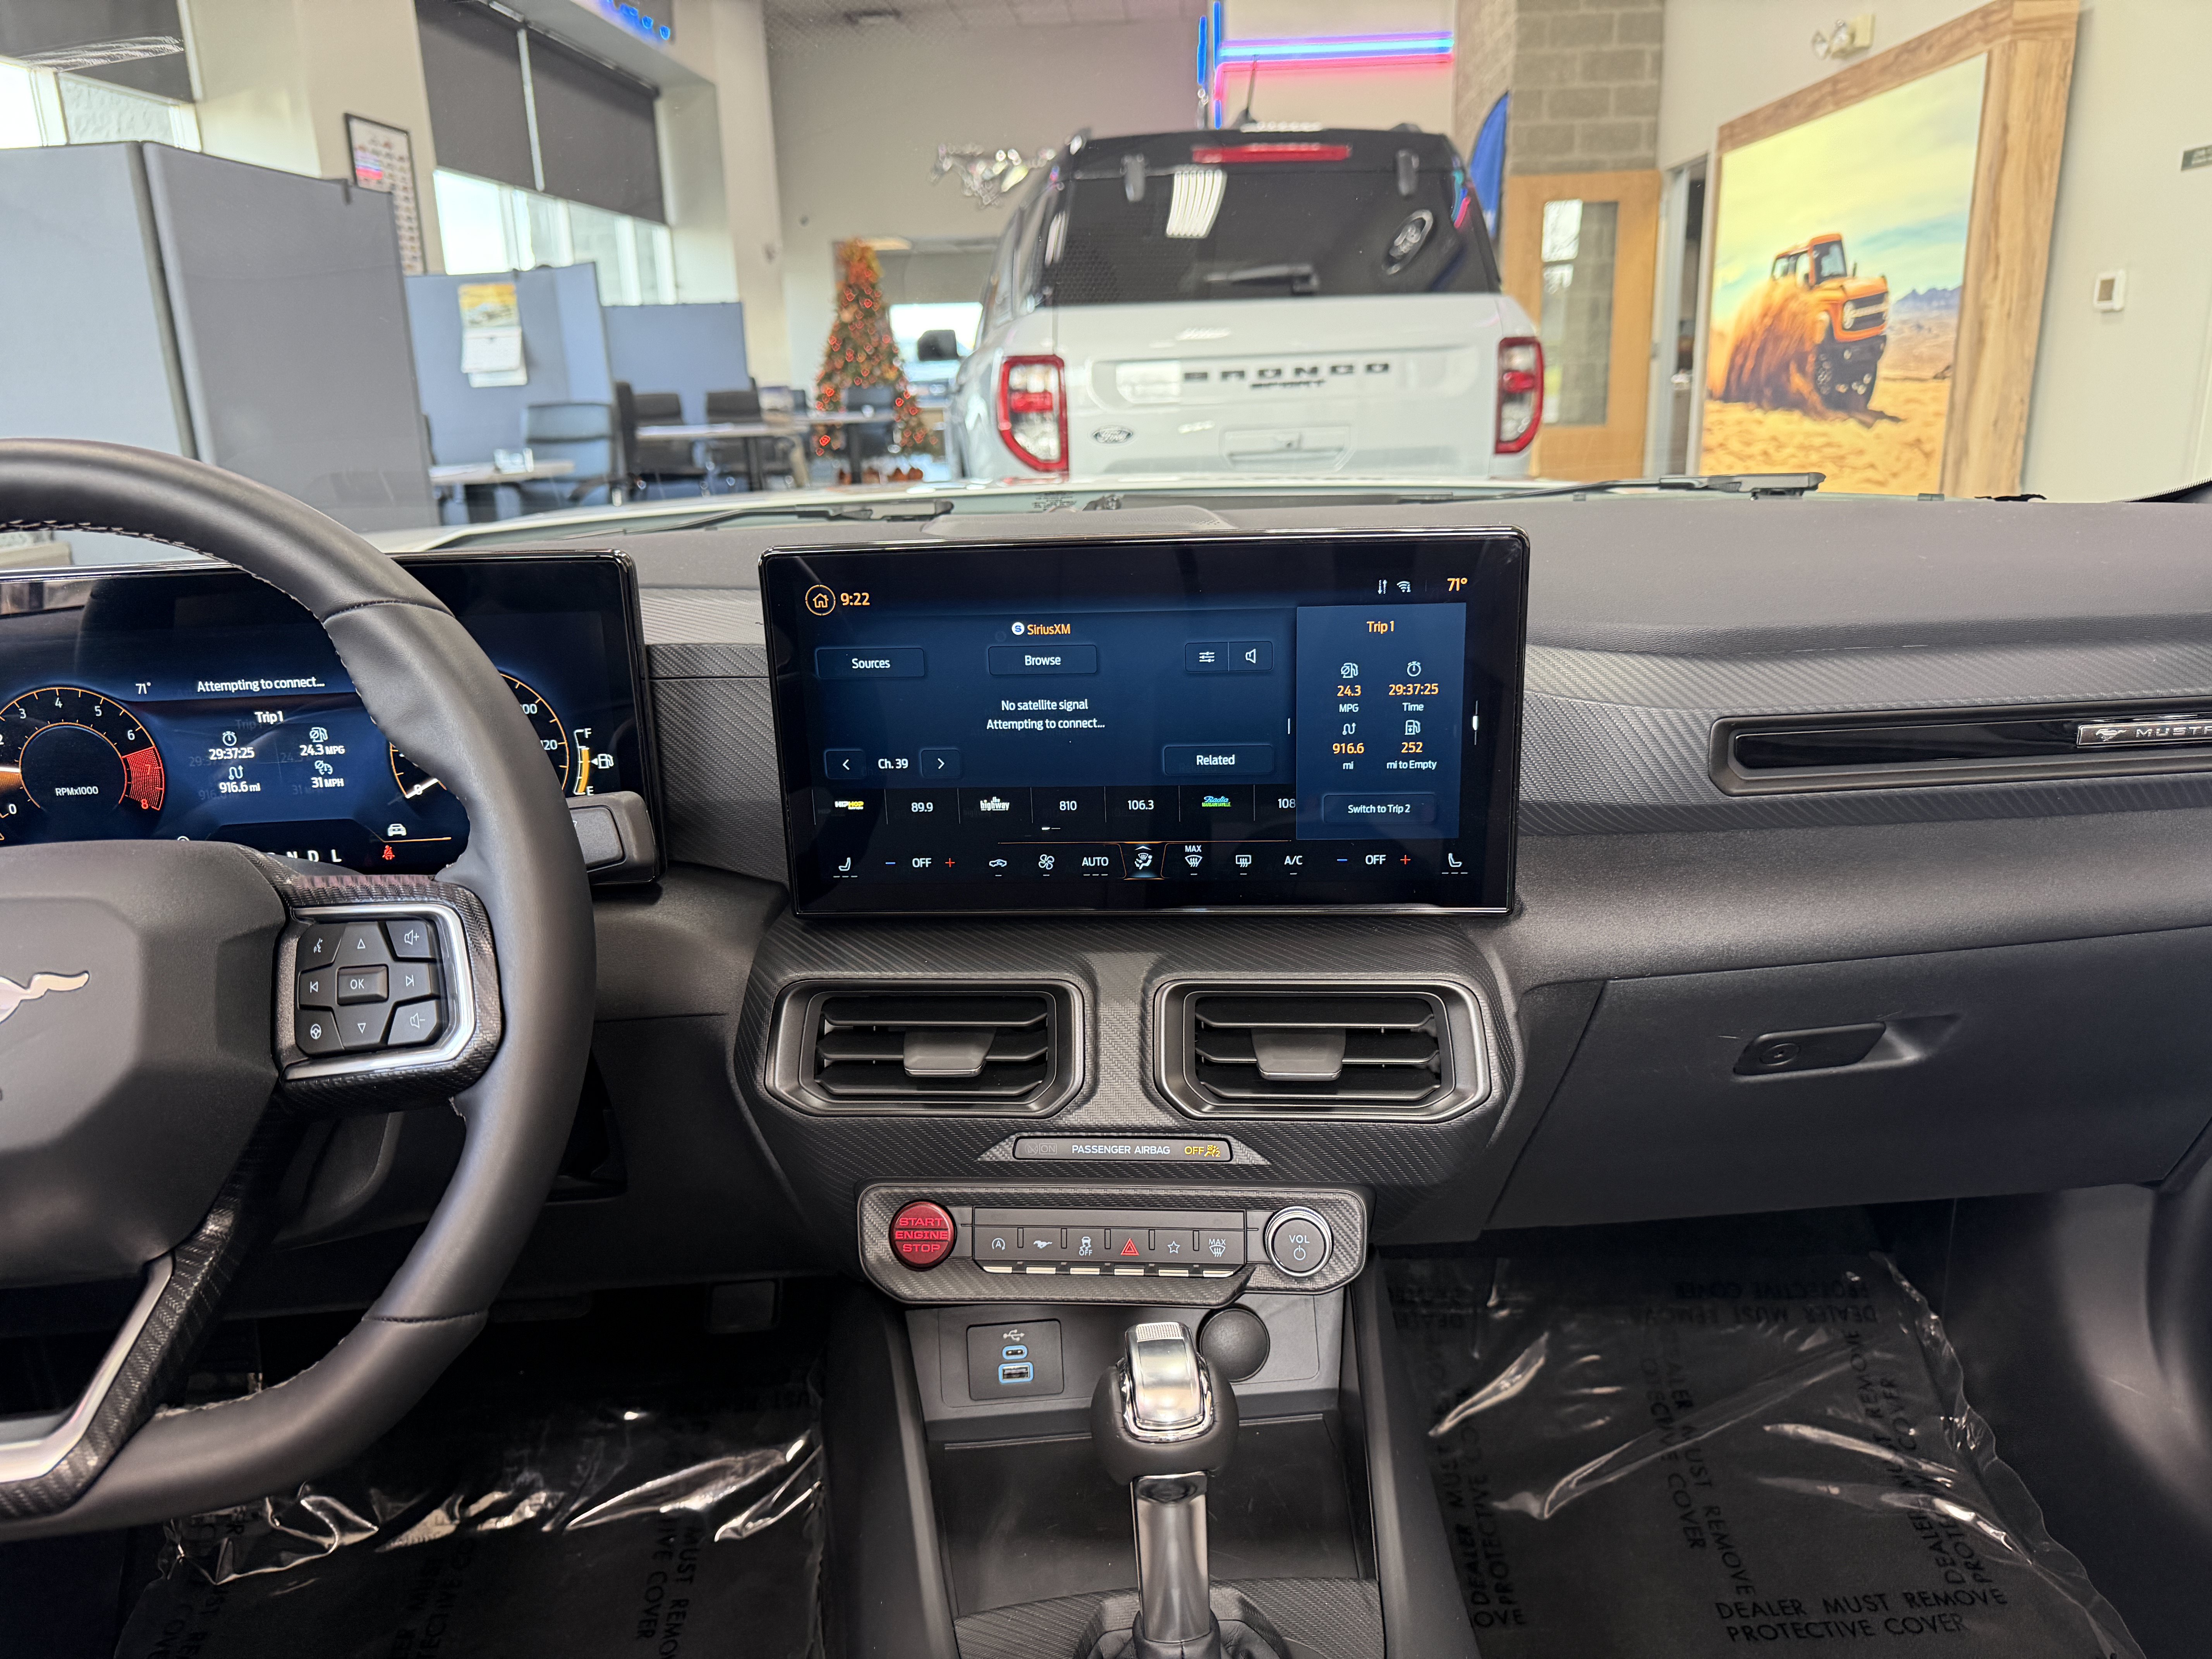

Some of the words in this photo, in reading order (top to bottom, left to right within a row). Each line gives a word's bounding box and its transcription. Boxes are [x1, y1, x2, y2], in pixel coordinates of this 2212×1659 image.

[1184, 363, 1390, 381] BRONCO
[1448, 578, 1467, 591] 71°
[841, 592, 870, 605] 9:22
[1027, 624, 1070, 635] SiriusXM
[1367, 621, 1388, 634] Trip
[1390, 621, 1394, 631] 1
[852, 658, 890, 668] Sources
[1025, 655, 1061, 665] Browse
[136, 682, 151, 694] 71°
[198, 679, 259, 692] Attempting
[261, 679, 273, 689] to
[273, 677, 325, 689] connect...
[1389, 684, 1438, 695] 29:37:25
[1337, 685, 1361, 696] 24.3
[55, 697, 63, 708] 4
[1001, 701, 1015, 710] No
[1018, 700, 1057, 710] satellite
[1058, 699, 1088, 711] signal
[1402, 702, 1424, 711] Time
[19, 708, 26, 718] 3
[94, 706, 102, 716] 5
[522, 704, 538, 715] 00
[1340, 704, 1359, 712] MPG
[254, 711, 276, 724] Trip
[278, 711, 283, 722] 1
[987, 719, 1043, 731] Attempting
[1045, 719, 1056, 728] to
[1058, 718, 1105, 728] connect...
[128, 730, 135, 740] 6
[584, 728, 591, 738] F
[300, 744, 324, 756] 24.3
[326, 745, 345, 754] MPG
[1333, 743, 1364, 754] 916.6
[1401, 742, 1422, 752] 252
[209, 747, 254, 760] 29:37:25
[878, 759, 894, 769] Ch.
[896, 759, 908, 768] 39
[1197, 754, 1235, 765] Related
[1387, 761, 1397, 769] mi
[1409, 760, 1437, 770] Empty
[219, 781, 248, 793] 916.6
[249, 783, 260, 792] mi
[311, 777, 323, 788] 31
[325, 778, 344, 787] MPH
[55, 786, 98, 796] RPMx1000
[587, 786, 594, 795] E
[141, 799, 148, 809] 8
[912, 802, 933, 812] 89.9
[980, 800, 1010, 811] highway
[1060, 801, 1077, 811] 810
[1128, 800, 1154, 810] 106.3
[1278, 799, 1295, 808] 108
[9, 804, 17, 814] 0
[1348, 805, 1377, 813] Switch
[1388, 804, 1403, 814] Trip
[1405, 804, 1410, 812] 2
[307, 850, 319, 862] D
[331, 849, 342, 862] L
[1285, 856, 1302, 865] A/C
[1365, 855, 1386, 864] OFF
[912, 858, 931, 867] OFF
[1082, 857, 1108, 866] AUTO
[350, 979, 364, 989] OK
[1072, 1145, 1131, 1154] PASSENGER
[1134, 1146, 1170, 1155] AIRBAG
[1184, 1146, 1204, 1155] OFF
[899, 1217, 942, 1227] START
[895, 1230, 949, 1240] ENGINE
[1288, 1235, 1310, 1243] VOL
[902, 1243, 941, 1253] STOP
[1668, 1473, 1707, 1549] COVER
[1704, 1505, 1757, 1595] REMOVE
[635, 1571, 667, 1639] COVER
[1714, 1599, 1807, 1620] DEALER
[1822, 1593, 1888, 1615] MUST
[1904, 1587, 2008, 1611] REMOVE
[1473, 1608, 1528, 1630] OVE
[1726, 1619, 1875, 1643] PROTECTIVE
[1883, 1613, 1967, 1636] COVER
